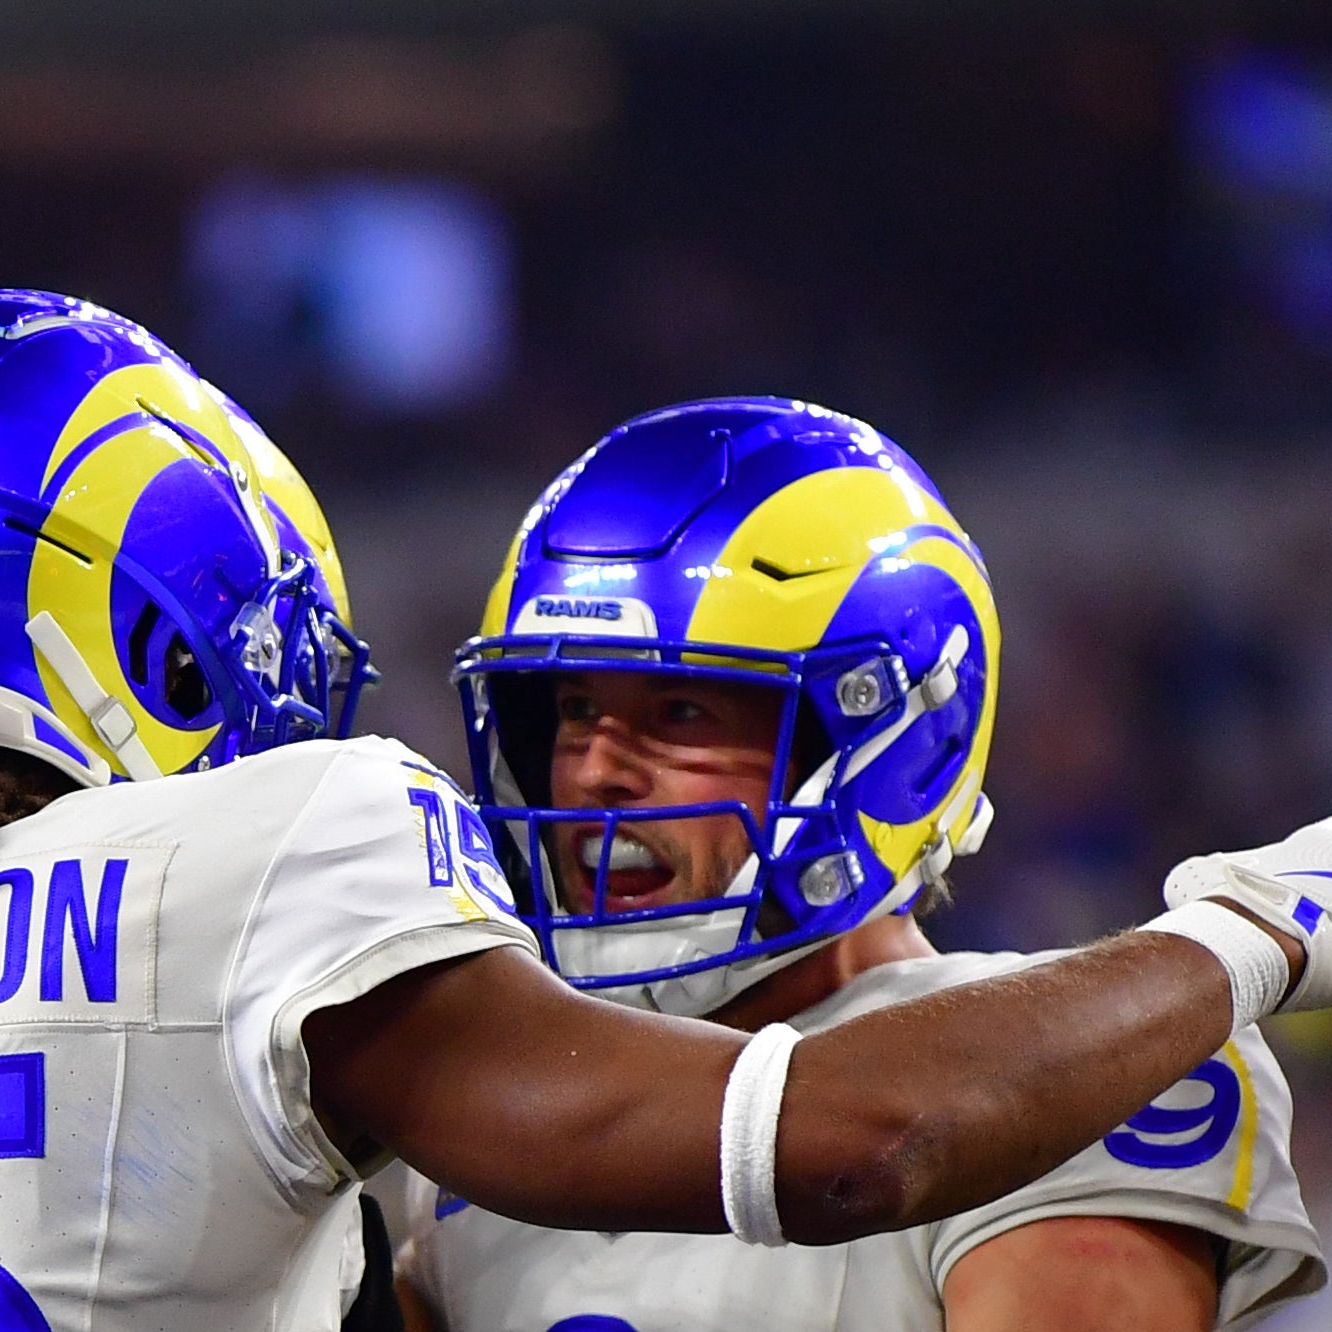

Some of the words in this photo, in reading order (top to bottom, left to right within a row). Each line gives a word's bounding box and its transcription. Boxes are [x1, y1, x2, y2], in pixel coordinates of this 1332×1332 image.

[535, 598, 622, 621] RAMS
[407, 787, 518, 919] 15
[1102, 1057, 1241, 1170] 9
